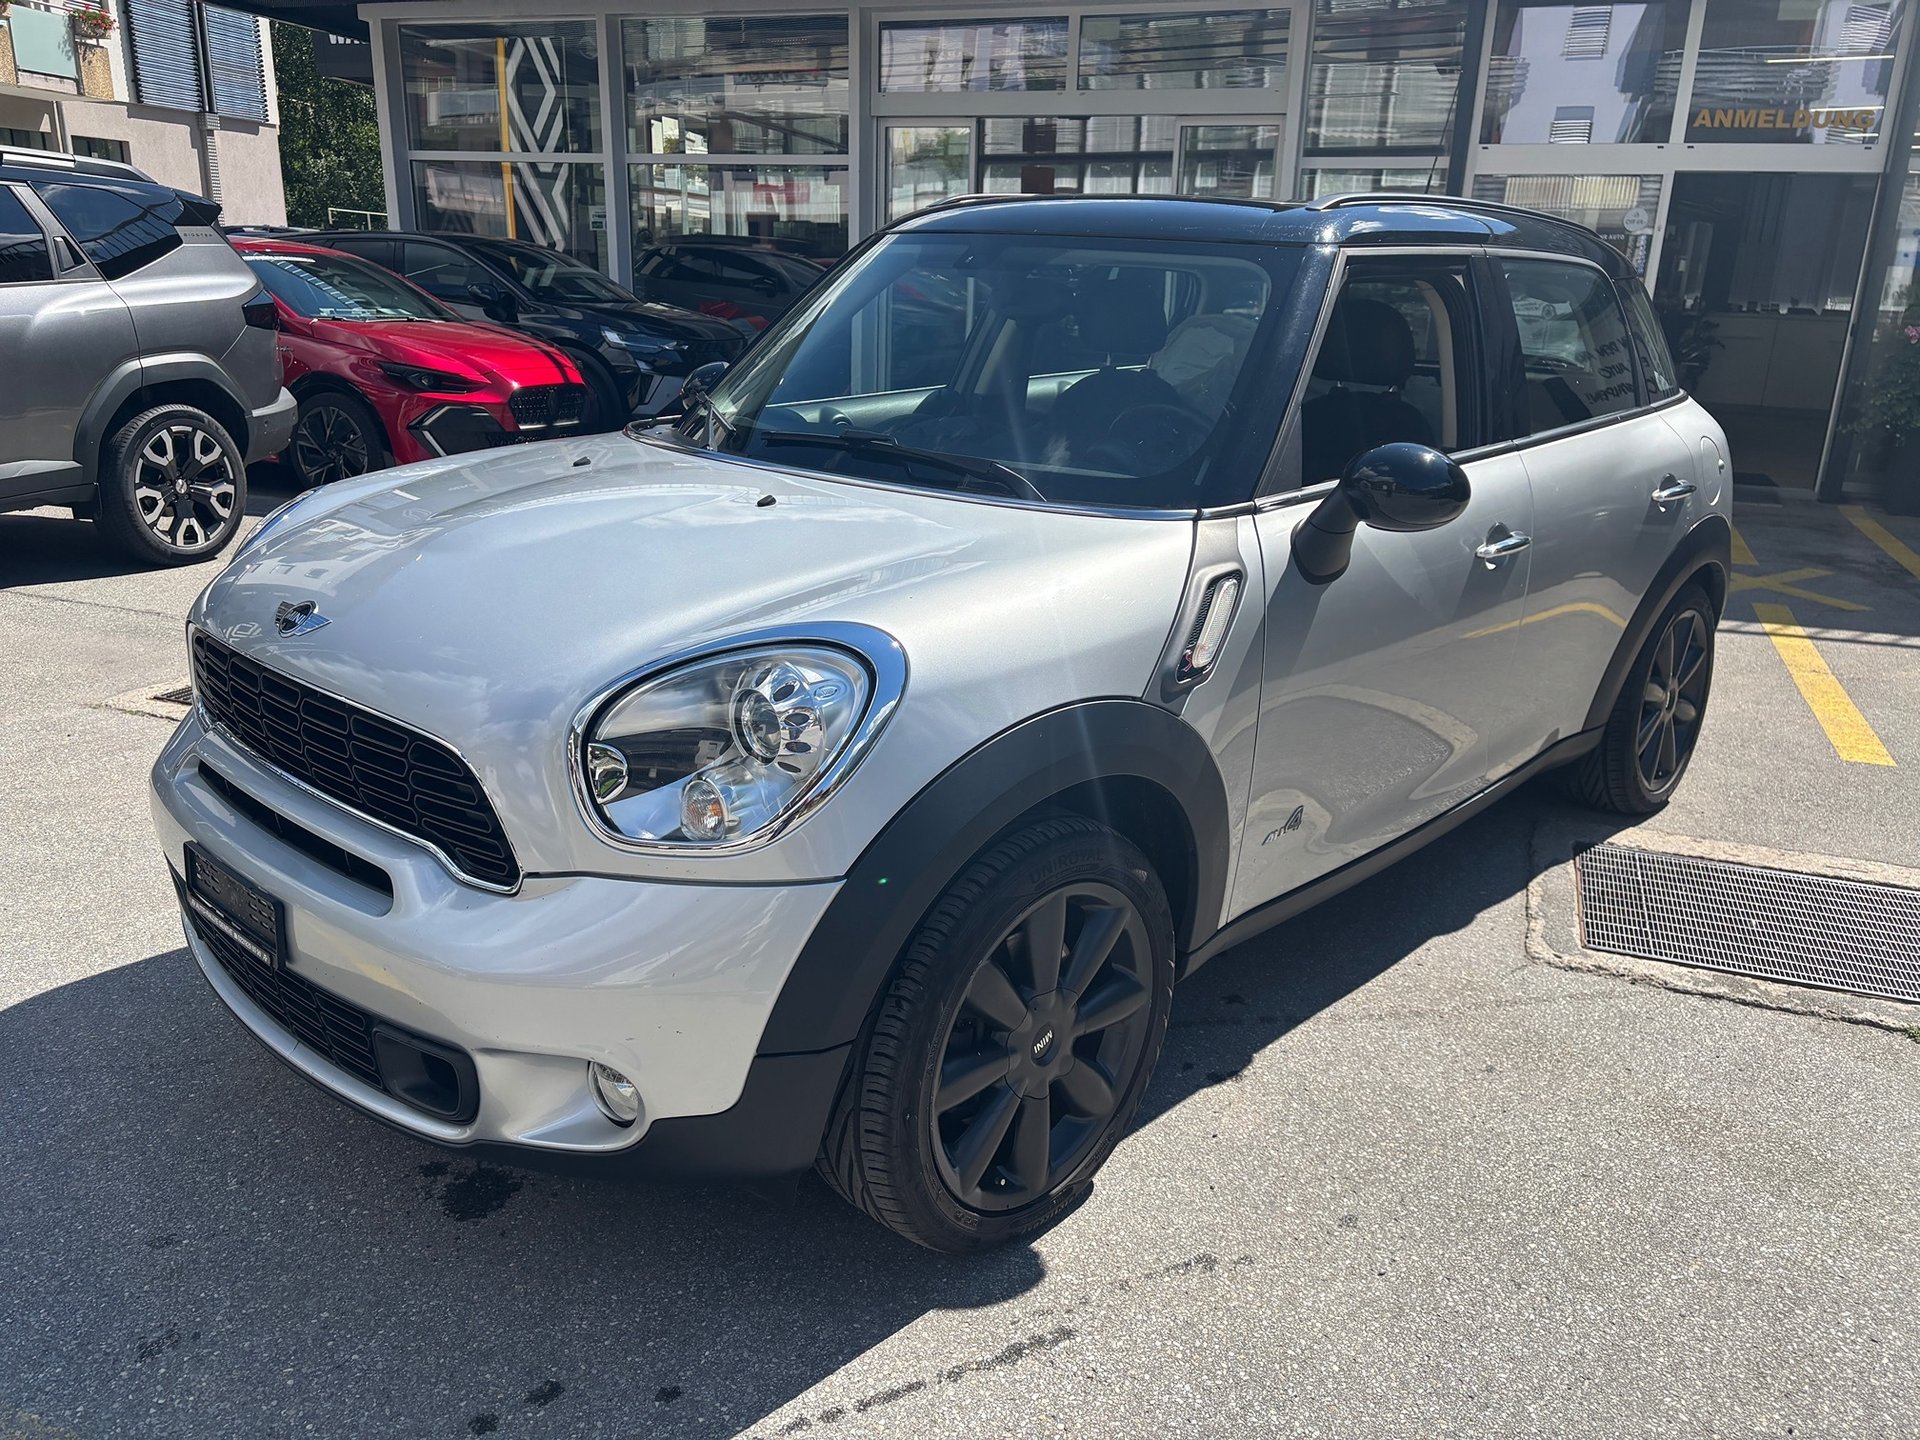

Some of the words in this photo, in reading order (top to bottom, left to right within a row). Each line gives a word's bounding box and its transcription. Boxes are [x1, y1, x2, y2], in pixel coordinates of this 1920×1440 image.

[1693, 109, 1876, 129] ANMELDUNG
[289, 610, 307, 625] MINI
[1033, 1029, 1053, 1054] MINI
